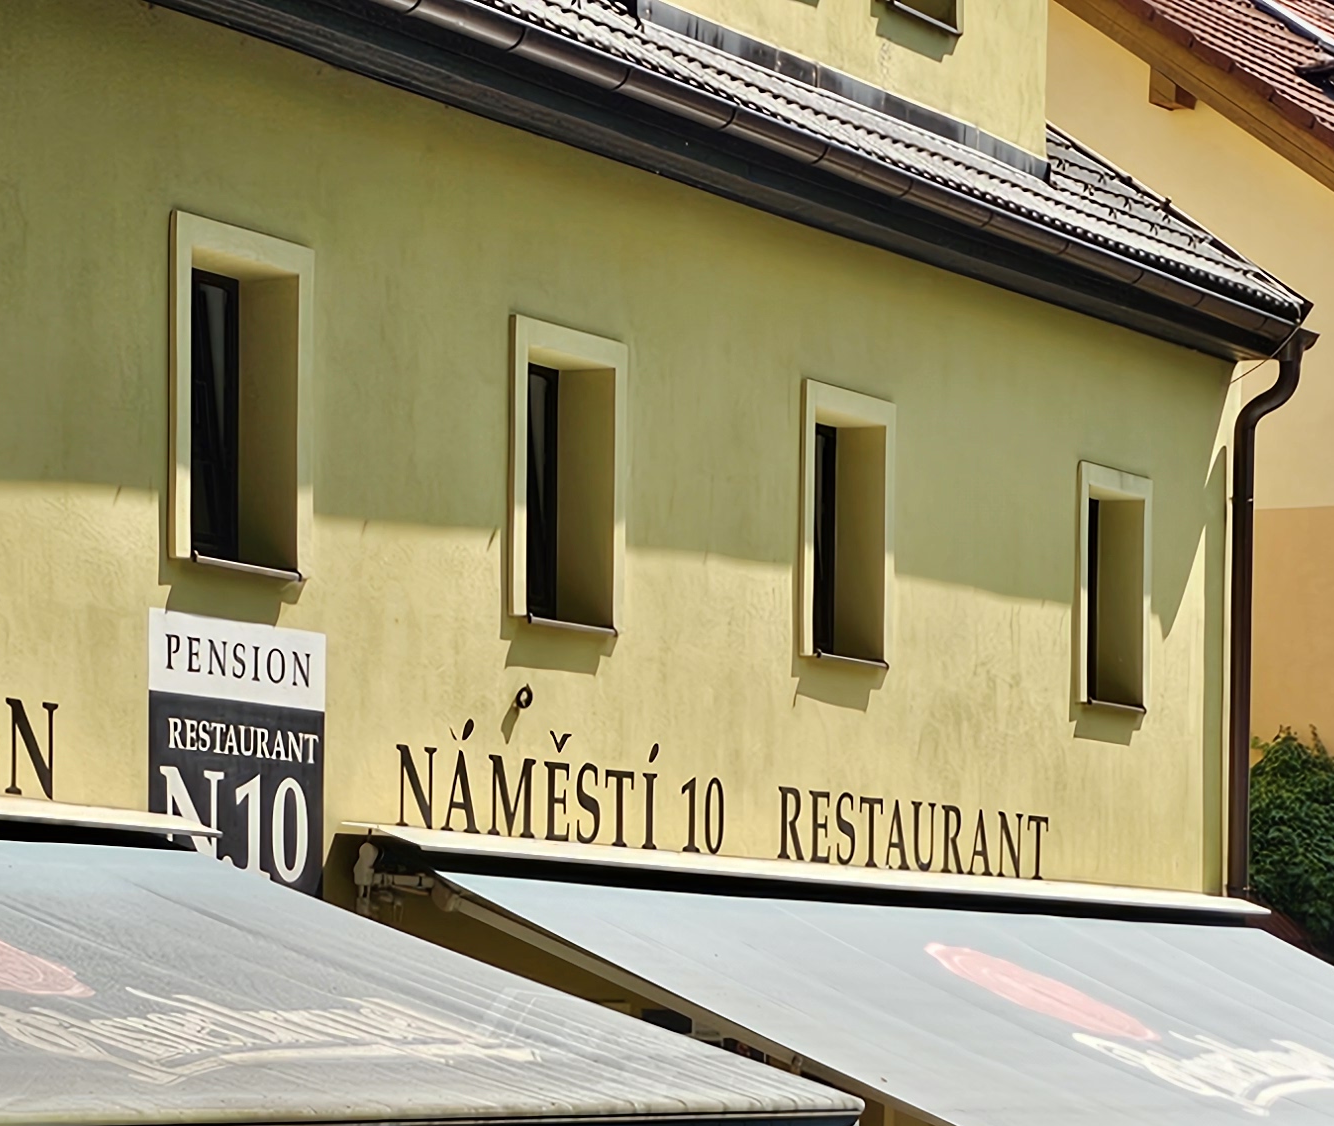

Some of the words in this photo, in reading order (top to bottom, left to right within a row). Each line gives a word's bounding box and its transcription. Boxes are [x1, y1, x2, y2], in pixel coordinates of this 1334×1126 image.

[165, 633, 312, 688] PENSION
[168, 717, 320, 765] RESTAURANT
[395, 718, 661, 849] NÁMĚSTÍ
[680, 776, 726, 855] 10
[777, 785, 1050, 882] RESTAURANT
